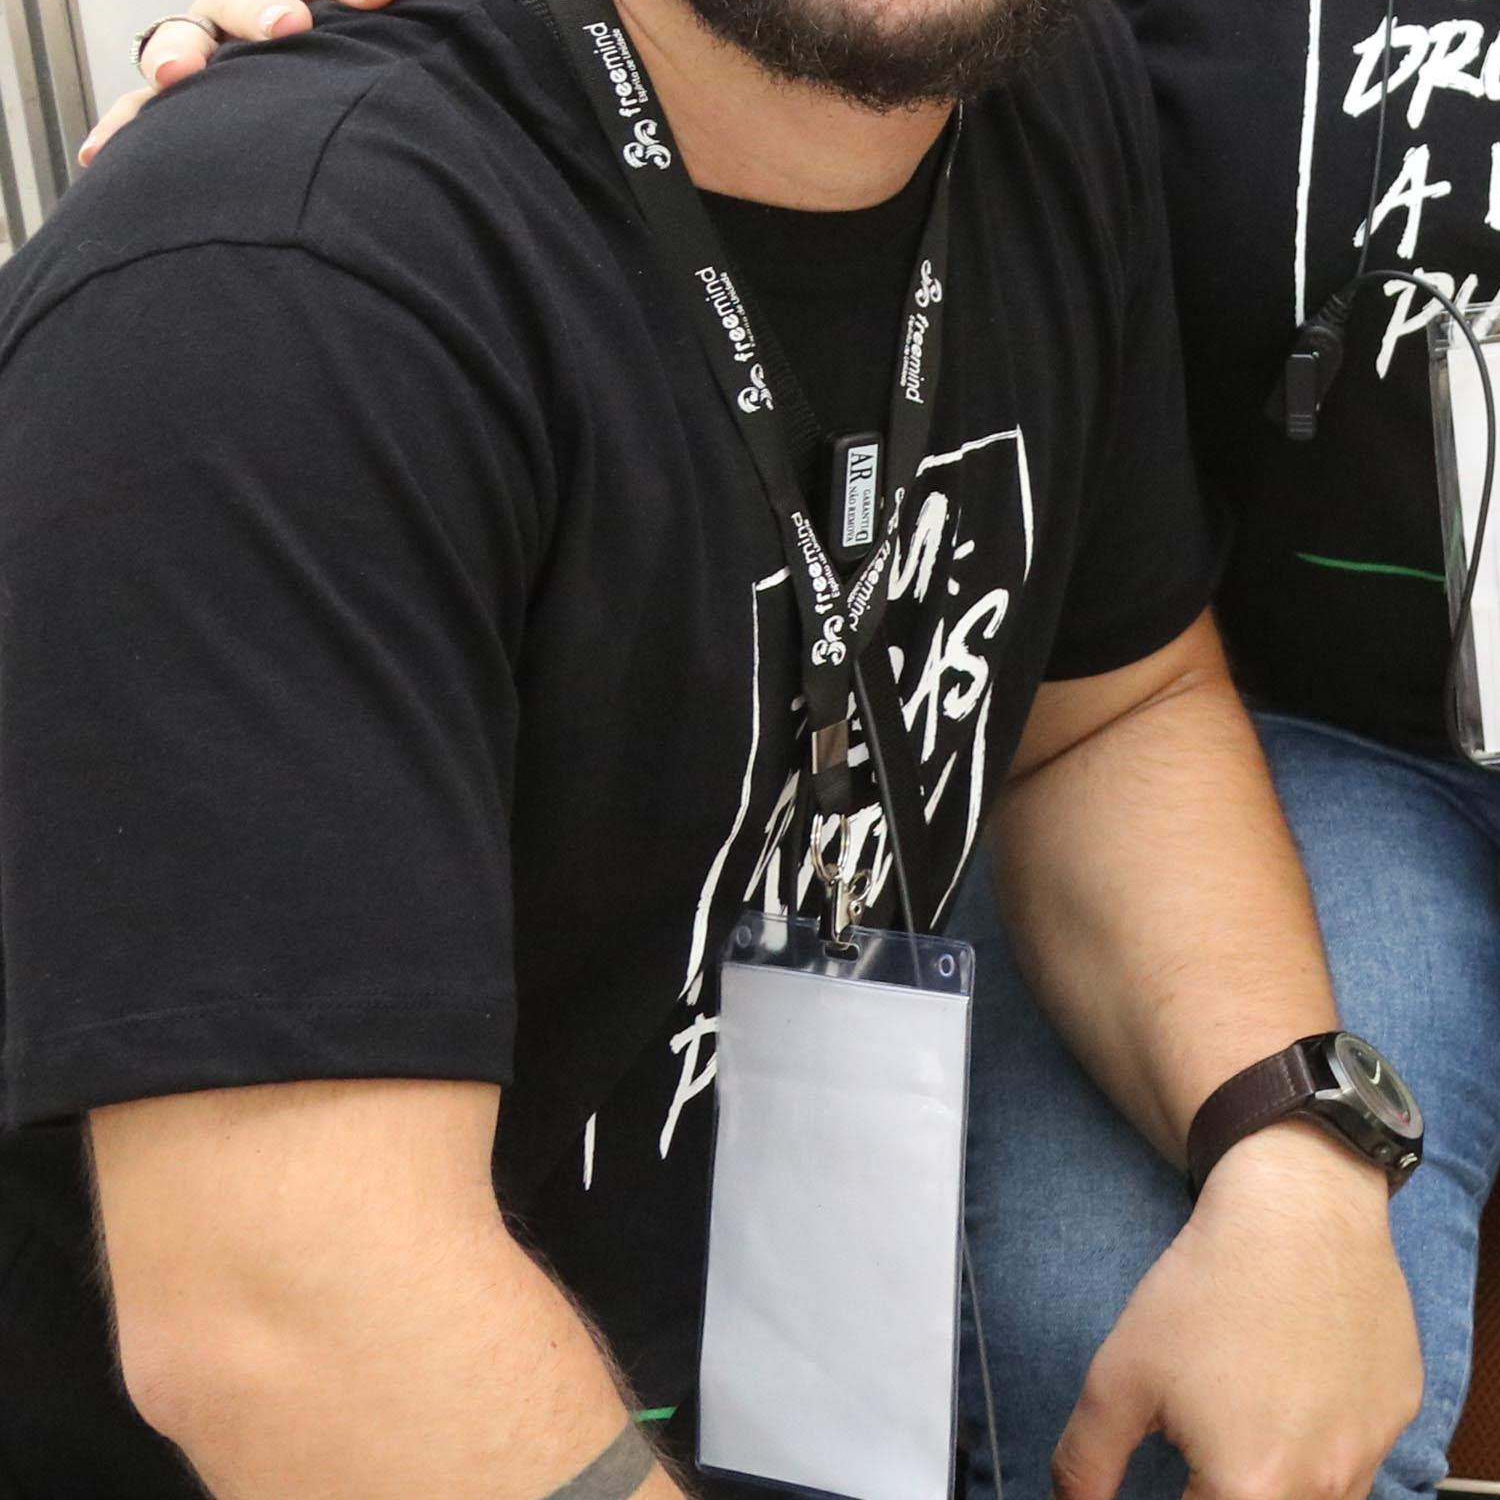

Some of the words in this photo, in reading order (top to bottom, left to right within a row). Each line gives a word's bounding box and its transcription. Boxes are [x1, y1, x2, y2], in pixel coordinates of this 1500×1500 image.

[582, 22, 642, 118] freemind
[1353, 143, 1452, 260] A
[694, 266, 755, 362] freemind
[905, 313, 930, 404] freemind
[849, 452, 874, 484] AR
[791, 511, 834, 615] freemind
[845, 507, 857, 542] REMOVA
